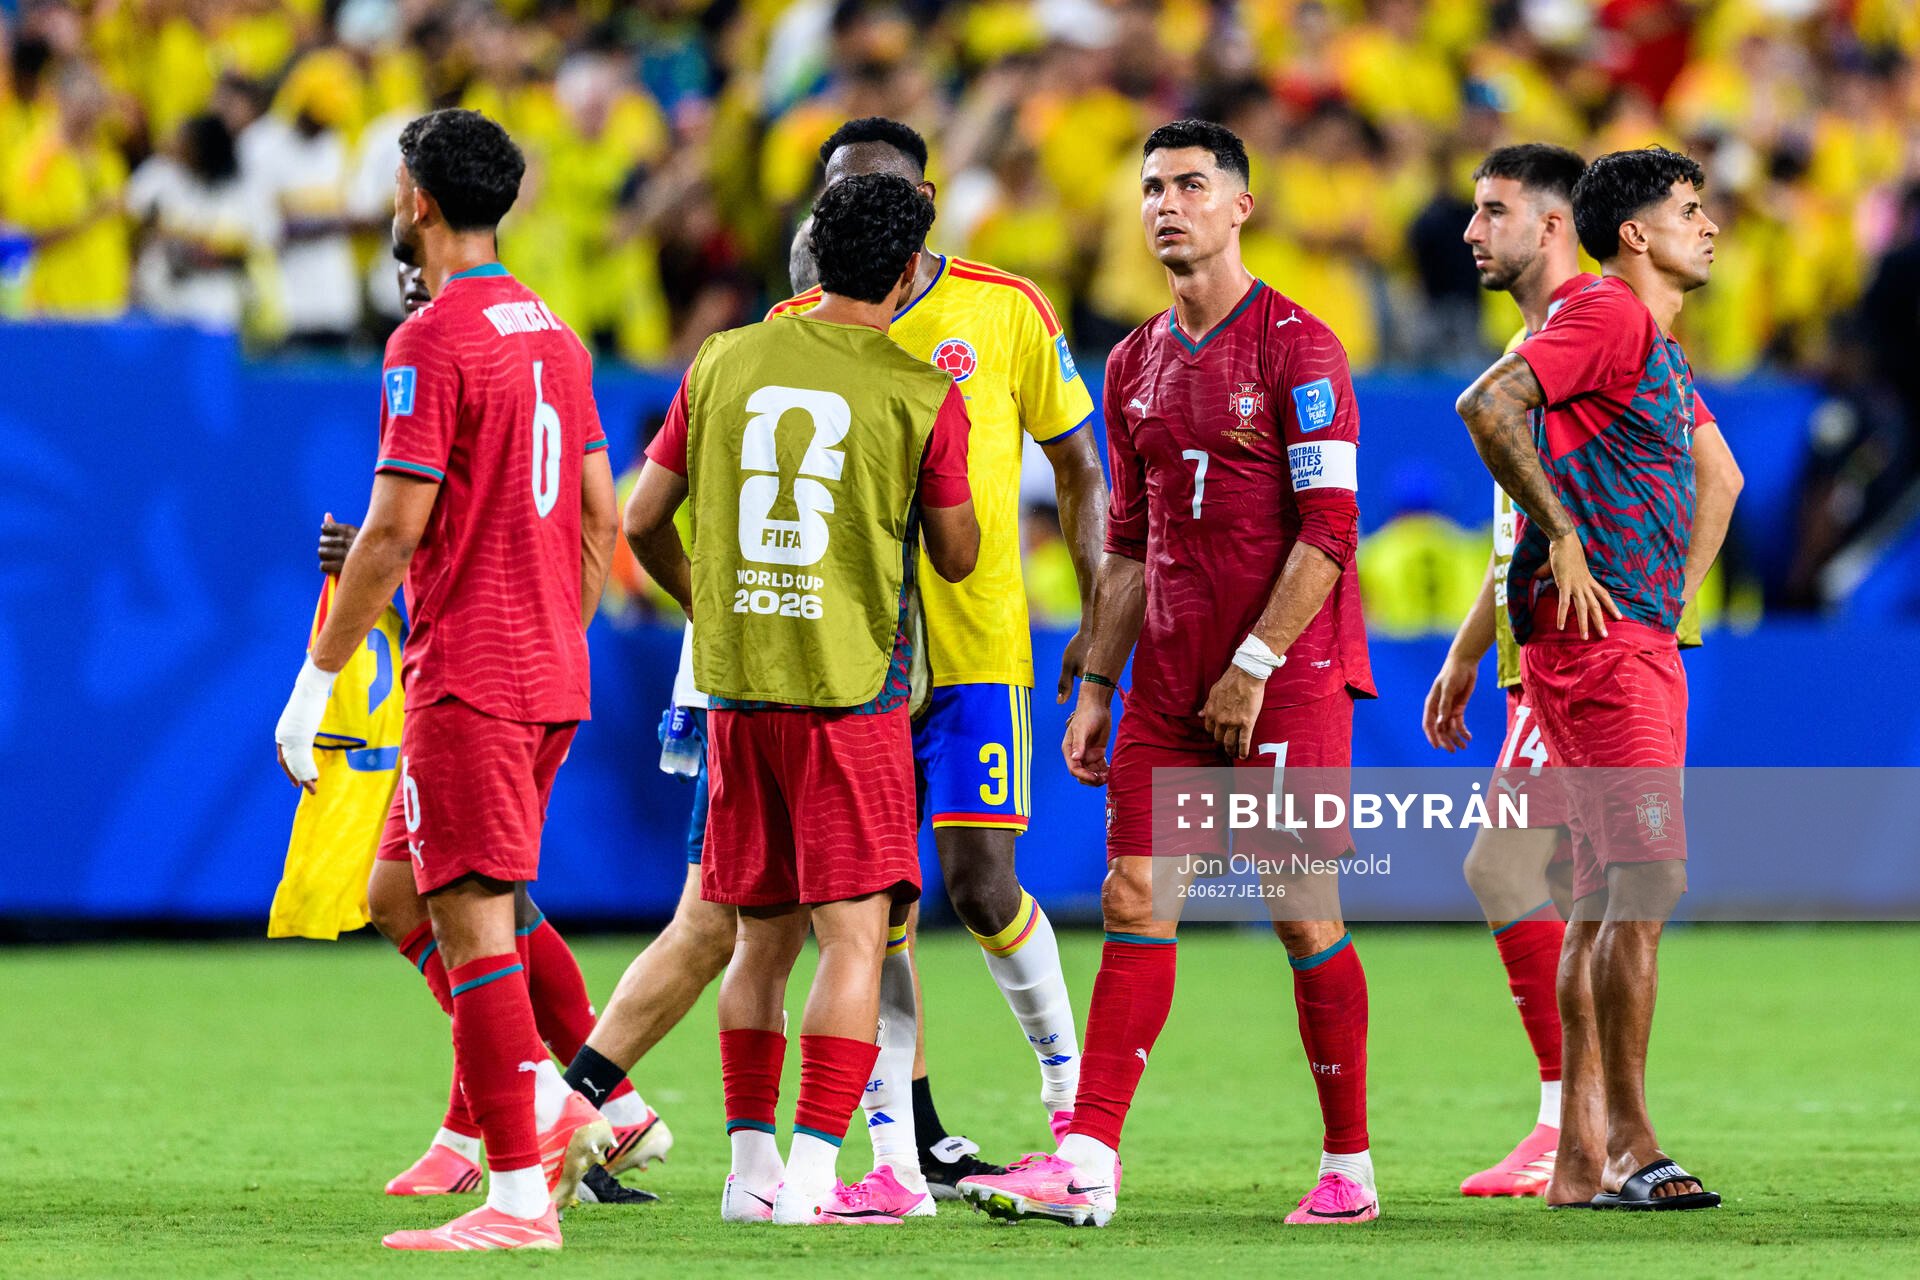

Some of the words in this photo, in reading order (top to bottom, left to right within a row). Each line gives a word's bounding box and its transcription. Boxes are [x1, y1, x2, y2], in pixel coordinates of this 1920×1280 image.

[532, 360, 562, 518] 6
[1182, 449, 1209, 519] 7
[761, 528, 801, 549] FIFA
[733, 588, 824, 620] 2026
[736, 569, 794, 589] WORLD
[796, 574, 824, 592] CUP
[979, 742, 1008, 806] 3
[1501, 705, 1549, 777] 14
[1258, 741, 1288, 815] 7
